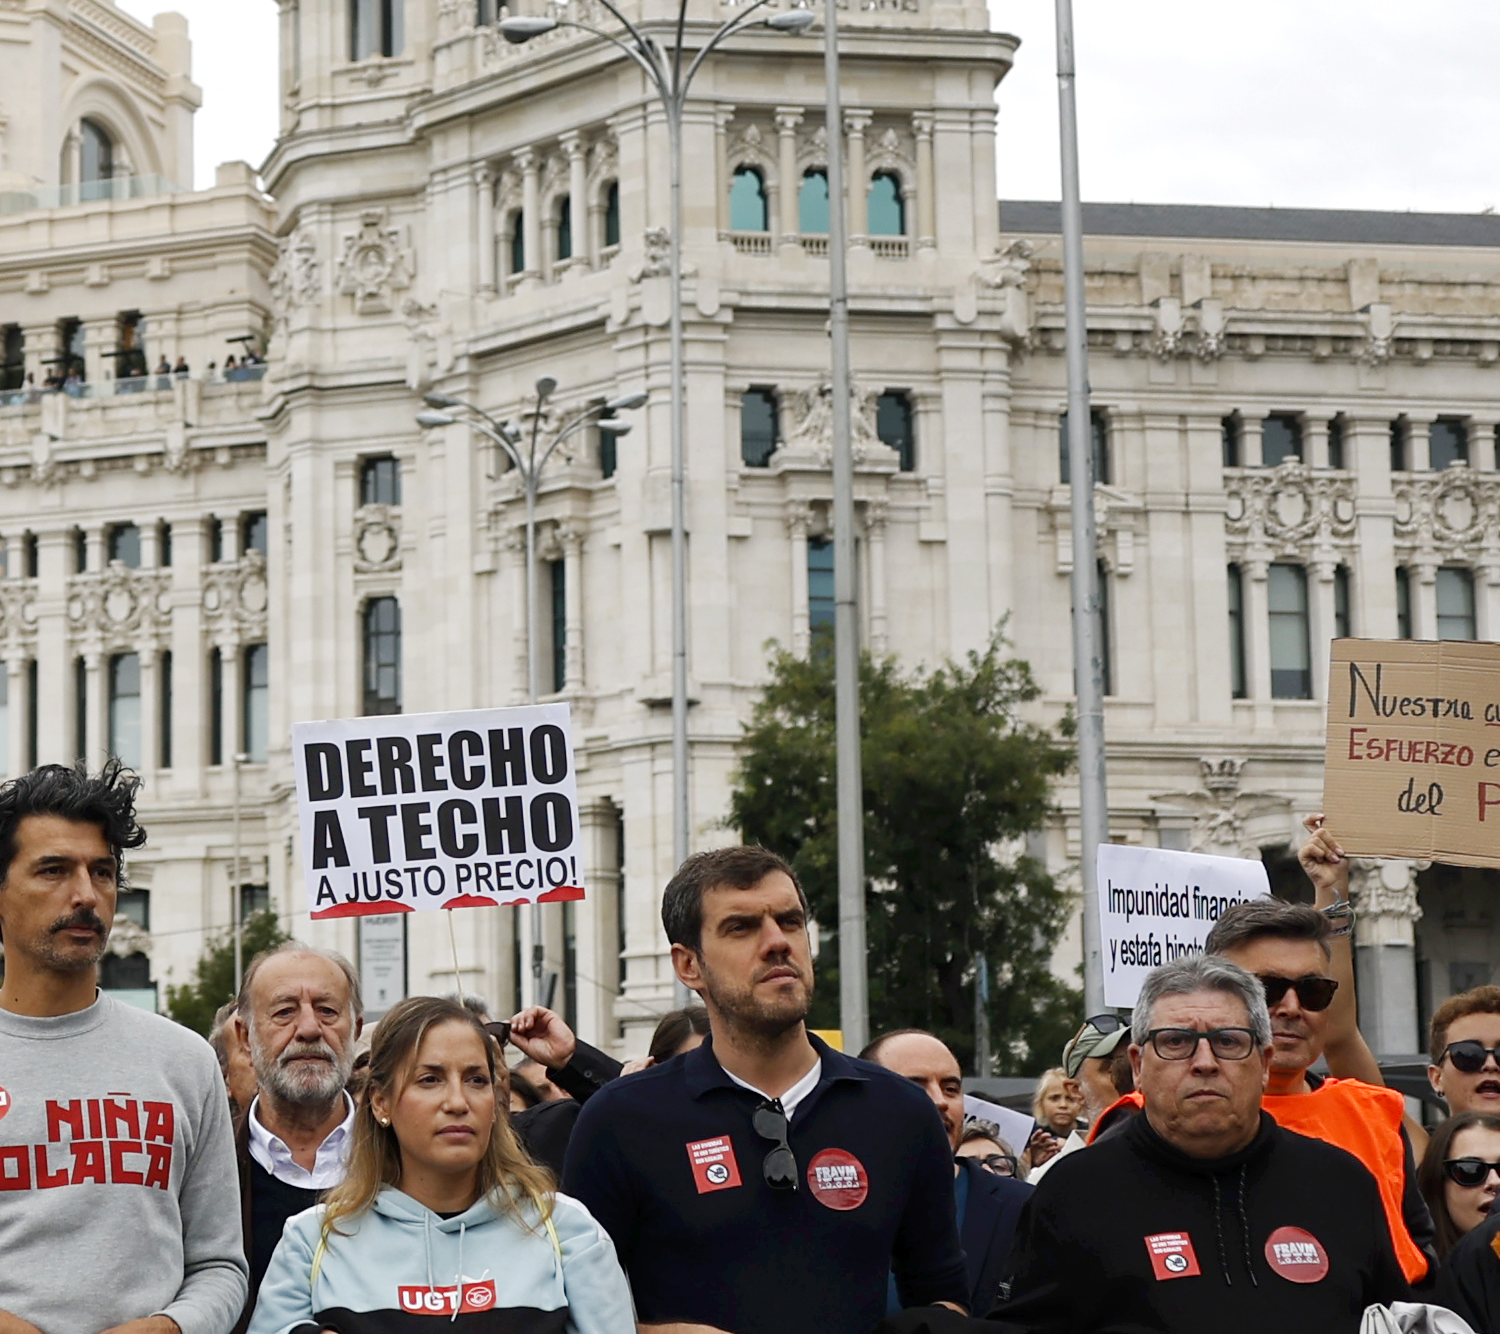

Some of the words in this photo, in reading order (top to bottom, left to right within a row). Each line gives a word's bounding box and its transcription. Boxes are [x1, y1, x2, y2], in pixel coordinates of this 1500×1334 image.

[304, 724, 568, 802] DERECHO
[1397, 777, 1443, 816] del
[312, 809, 351, 870] A
[358, 792, 574, 864] TECHO
[316, 875, 337, 906] A
[345, 864, 445, 903] JUSTO
[455, 855, 577, 894] PRECIO!
[1108, 879, 1190, 923] Impunidad
[1110, 938, 1117, 973] y
[1120, 932, 1162, 967] estafa
[45, 1091, 174, 1145] NIÑA
[402, 1291, 458, 1311] UGT
